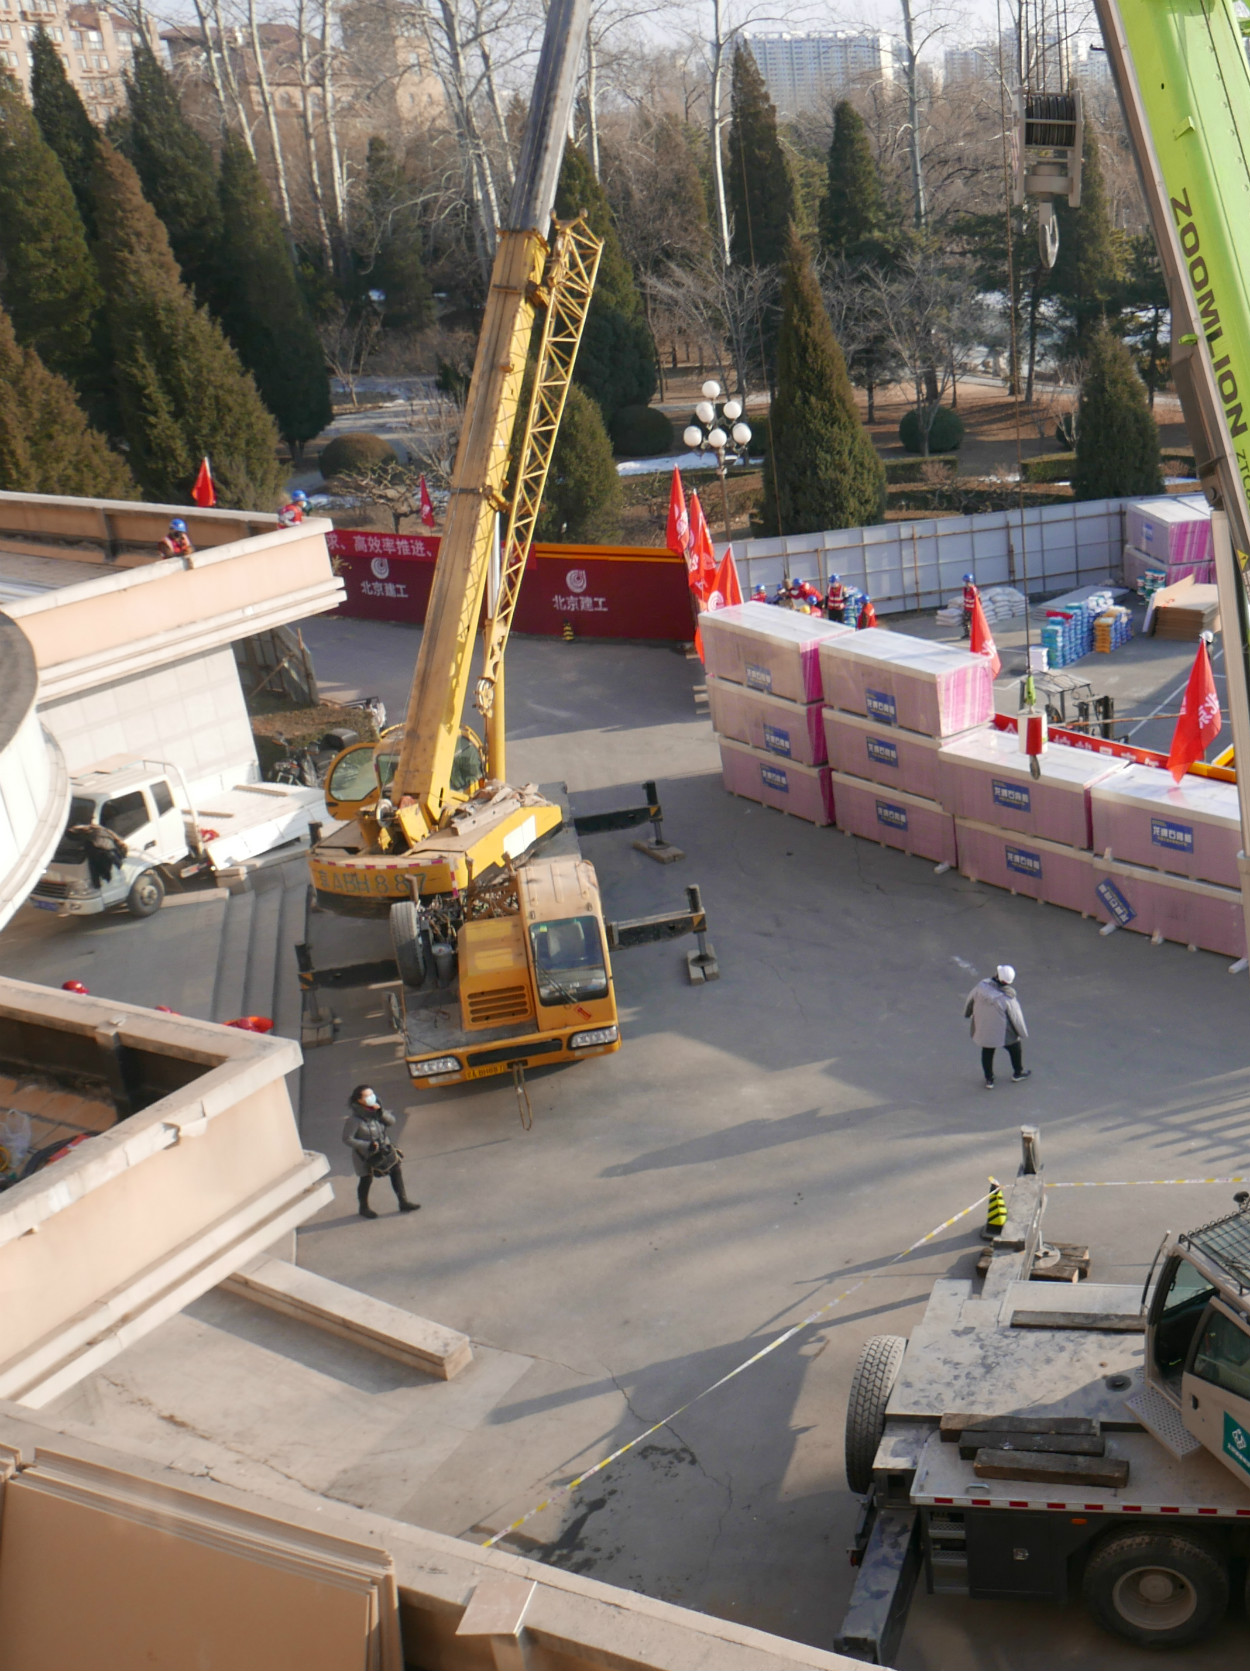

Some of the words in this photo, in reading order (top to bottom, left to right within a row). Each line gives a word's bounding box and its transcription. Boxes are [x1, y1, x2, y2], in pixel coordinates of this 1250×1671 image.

[1171, 188, 1248, 438] ZOOMLION
[360, 581, 409, 598] 北京建工
[552, 594, 608, 612] 北京建工
